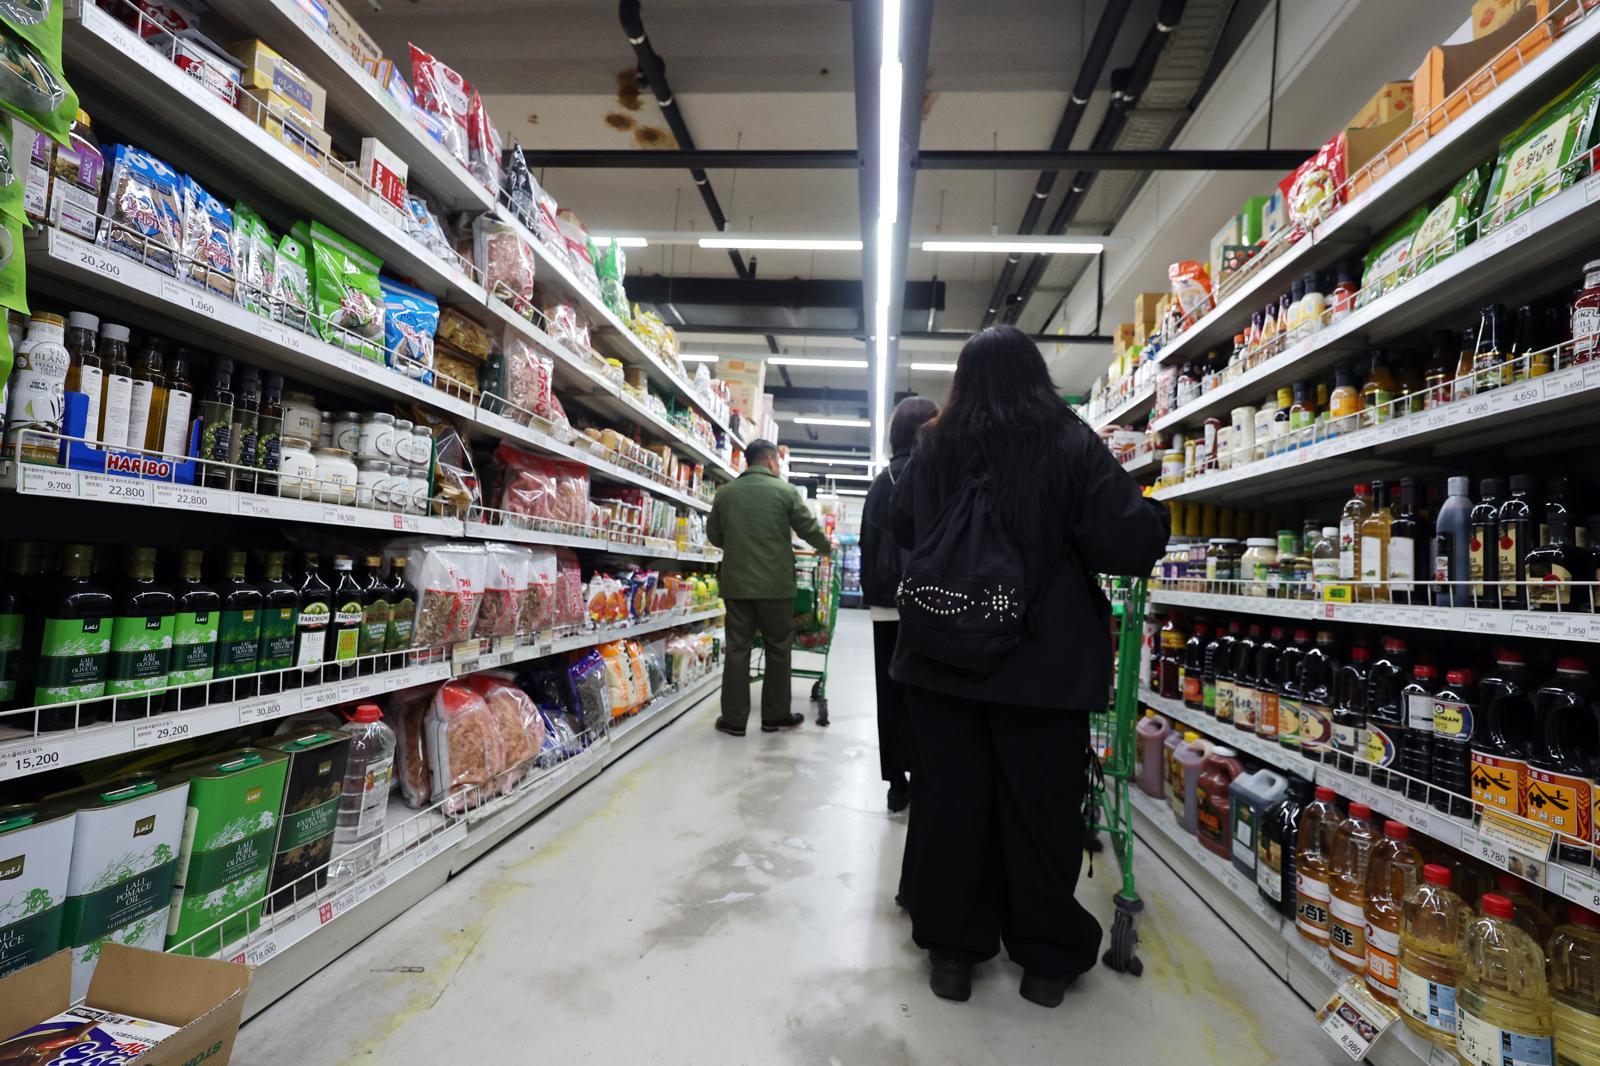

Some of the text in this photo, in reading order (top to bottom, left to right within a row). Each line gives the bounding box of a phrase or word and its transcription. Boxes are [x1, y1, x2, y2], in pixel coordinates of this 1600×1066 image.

[80, 252, 120, 276] 20,200
[189, 297, 214, 314] 1,060
[1563, 381, 1582, 391] 5,650
[1512, 389, 1537, 402] 4,650
[107, 455, 169, 477] HARIBO
[47, 481, 71, 490] 9,700
[109, 485, 145, 498] 22,800
[177, 494, 208, 506] 22,800
[336, 513, 356, 523] 19,500
[1566, 627, 1586, 635] 3,950
[71, 666, 88, 674] OLIVE
[256, 704, 281, 717] 30,800
[157, 724, 189, 739] 29,200
[16, 752, 59, 770] 15,200
[227, 849, 258, 868] OLIVE OIL
[1482, 847, 1506, 864] 8,780
[126, 877, 146, 890] LALI
[115, 881, 152, 904] POMACE
[125, 895, 140, 906] OIL
[251, 943, 277, 963] 118,000
[1341, 1035, 1362, 1056] 8,980
